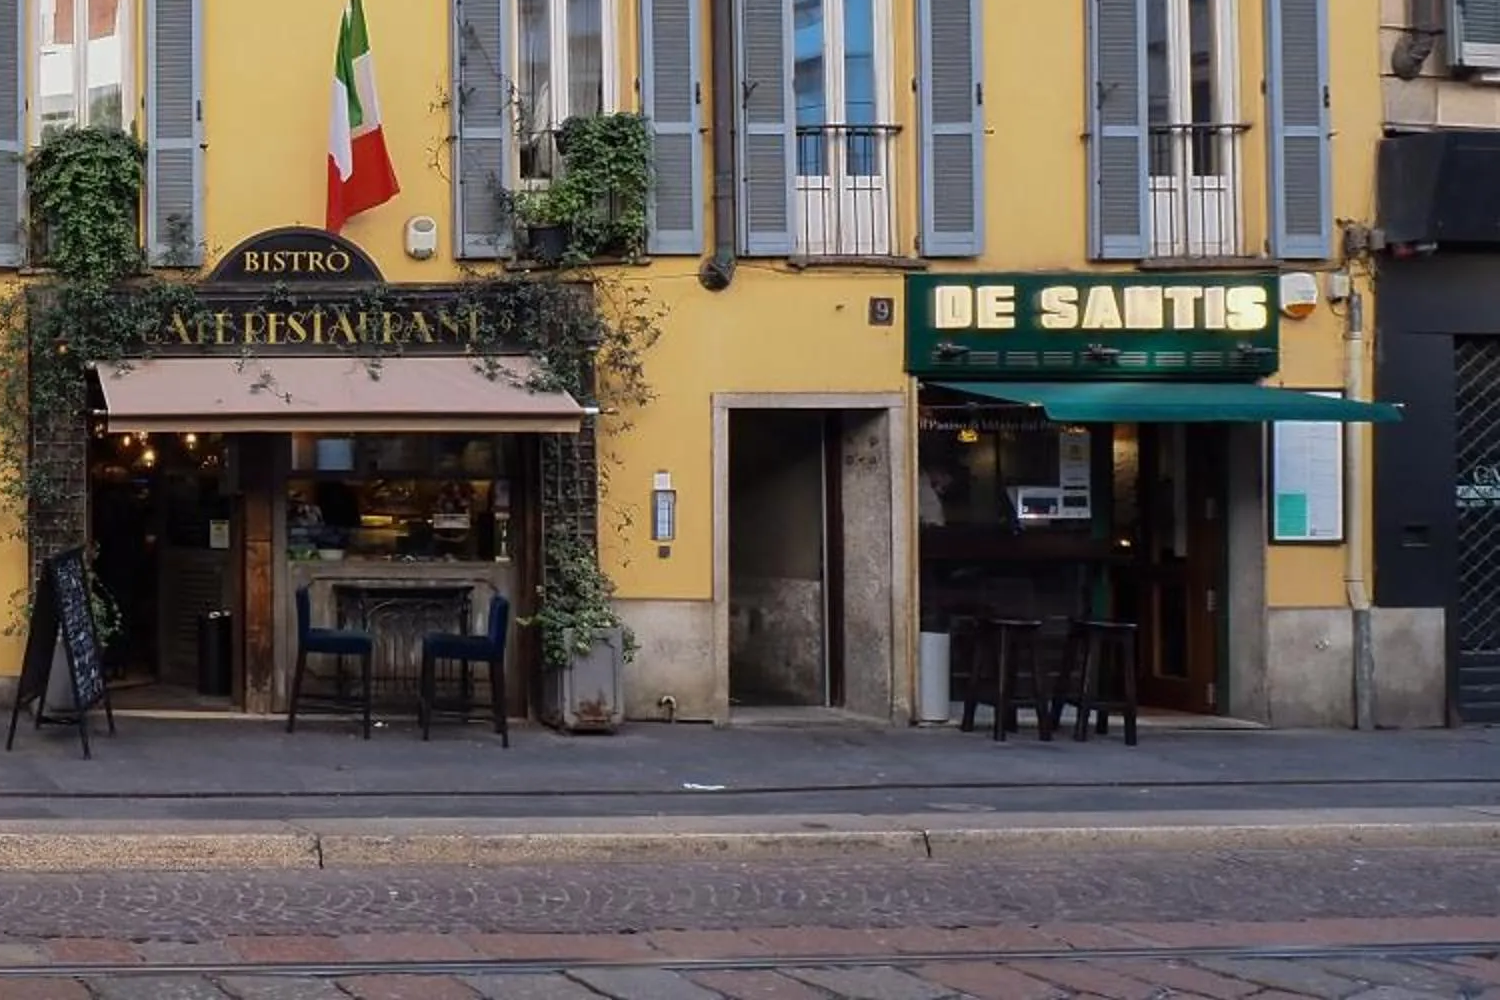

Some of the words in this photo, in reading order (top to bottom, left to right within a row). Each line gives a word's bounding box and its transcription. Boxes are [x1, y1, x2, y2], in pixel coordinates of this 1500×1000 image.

[243, 244, 351, 273] BISTRÒ
[875, 300, 890, 321] 9
[934, 285, 1016, 330] DE
[1039, 284, 1268, 331] SANTIS
